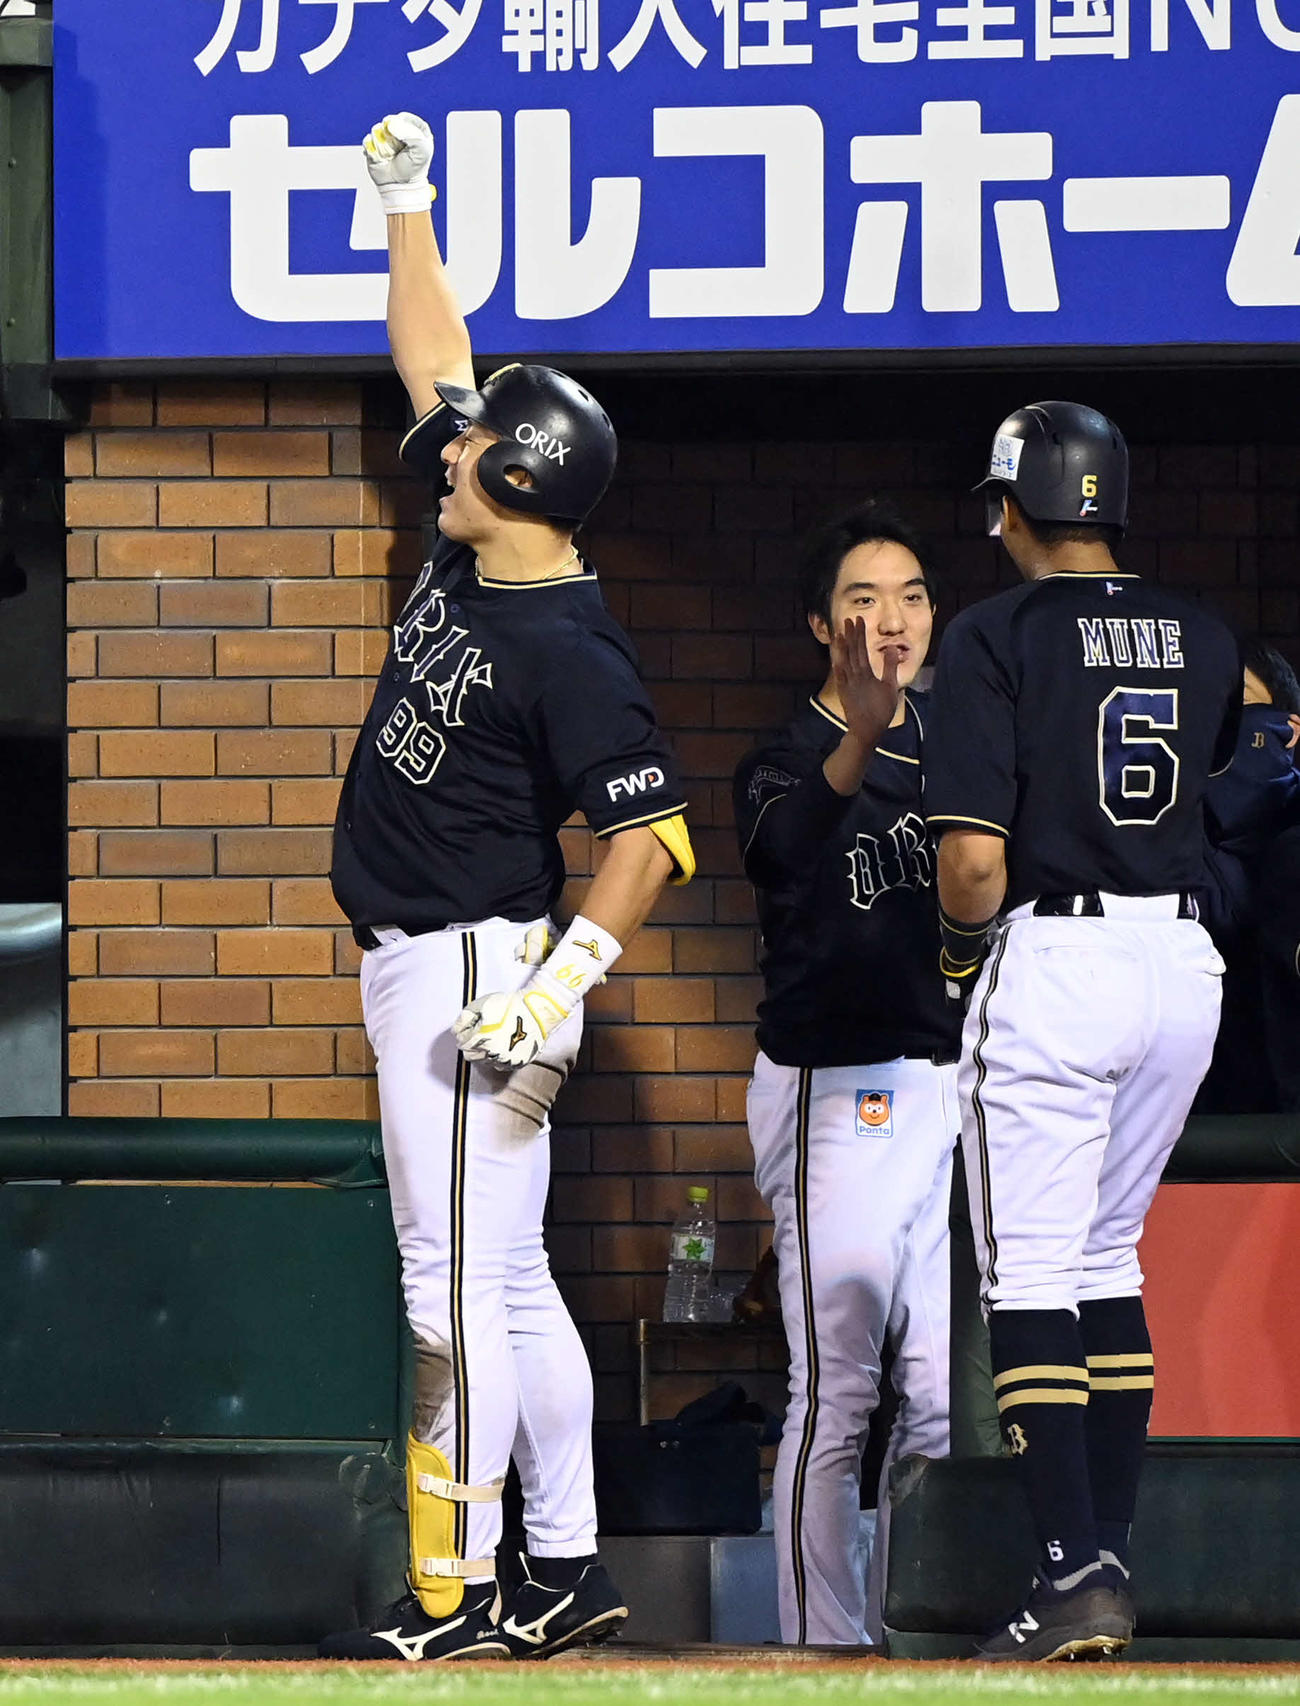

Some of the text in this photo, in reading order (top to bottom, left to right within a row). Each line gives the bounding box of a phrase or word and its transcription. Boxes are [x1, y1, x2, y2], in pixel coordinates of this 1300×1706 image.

[515, 422, 572, 466] ORIX
[1081, 474, 1098, 498] 6
[1077, 617, 1185, 669] MUNE
[375, 697, 447, 785] 99
[1097, 686, 1180, 827] 6
[606, 766, 665, 802] FWD
[859, 1125, 890, 1135] Ponta
[1047, 1540, 1064, 1562] 6
